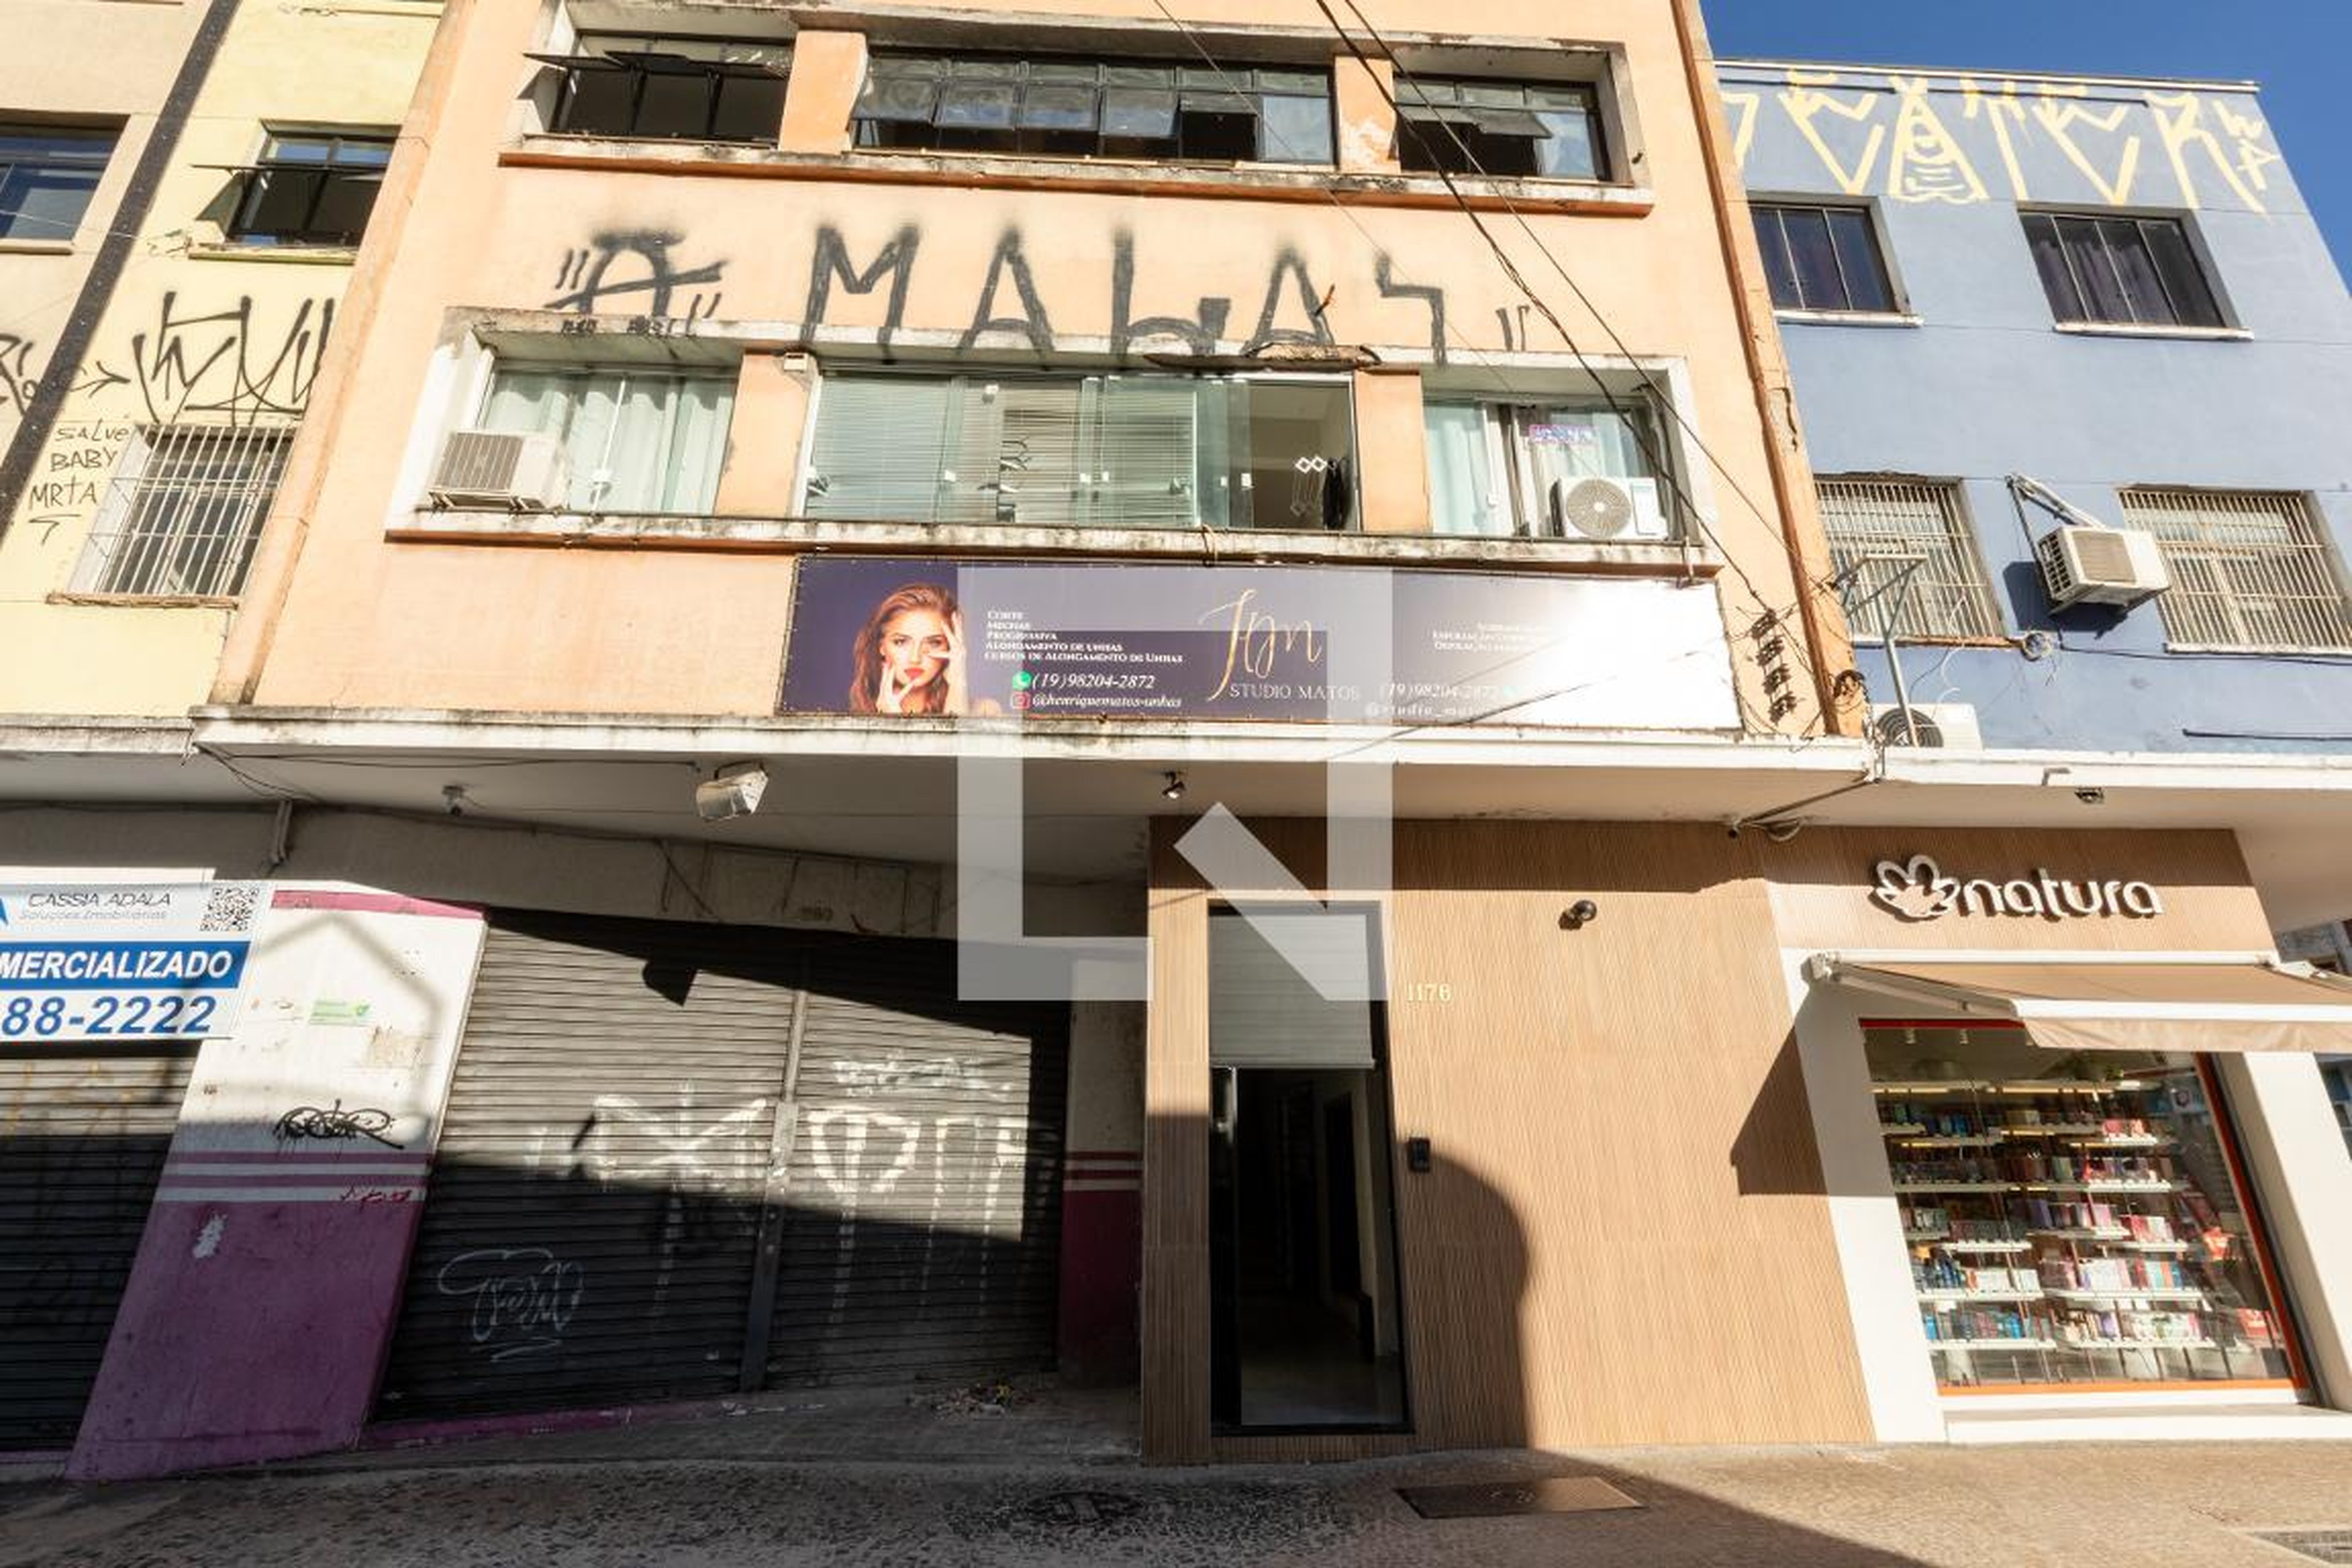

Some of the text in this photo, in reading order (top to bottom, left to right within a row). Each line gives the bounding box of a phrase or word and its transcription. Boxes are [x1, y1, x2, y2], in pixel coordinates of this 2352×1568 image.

[50, 447, 118, 472] BABY
[1032, 673, 1156, 690] (19)98204-2872
[1229, 682, 1361, 701] STUDIO MATOS
[28, 892, 171, 908] CASSIA ADALA
[1964, 867, 2164, 919] natura
[1407, 982, 1452, 1002] 1176
[2, 996, 217, 1036] 88-2222
